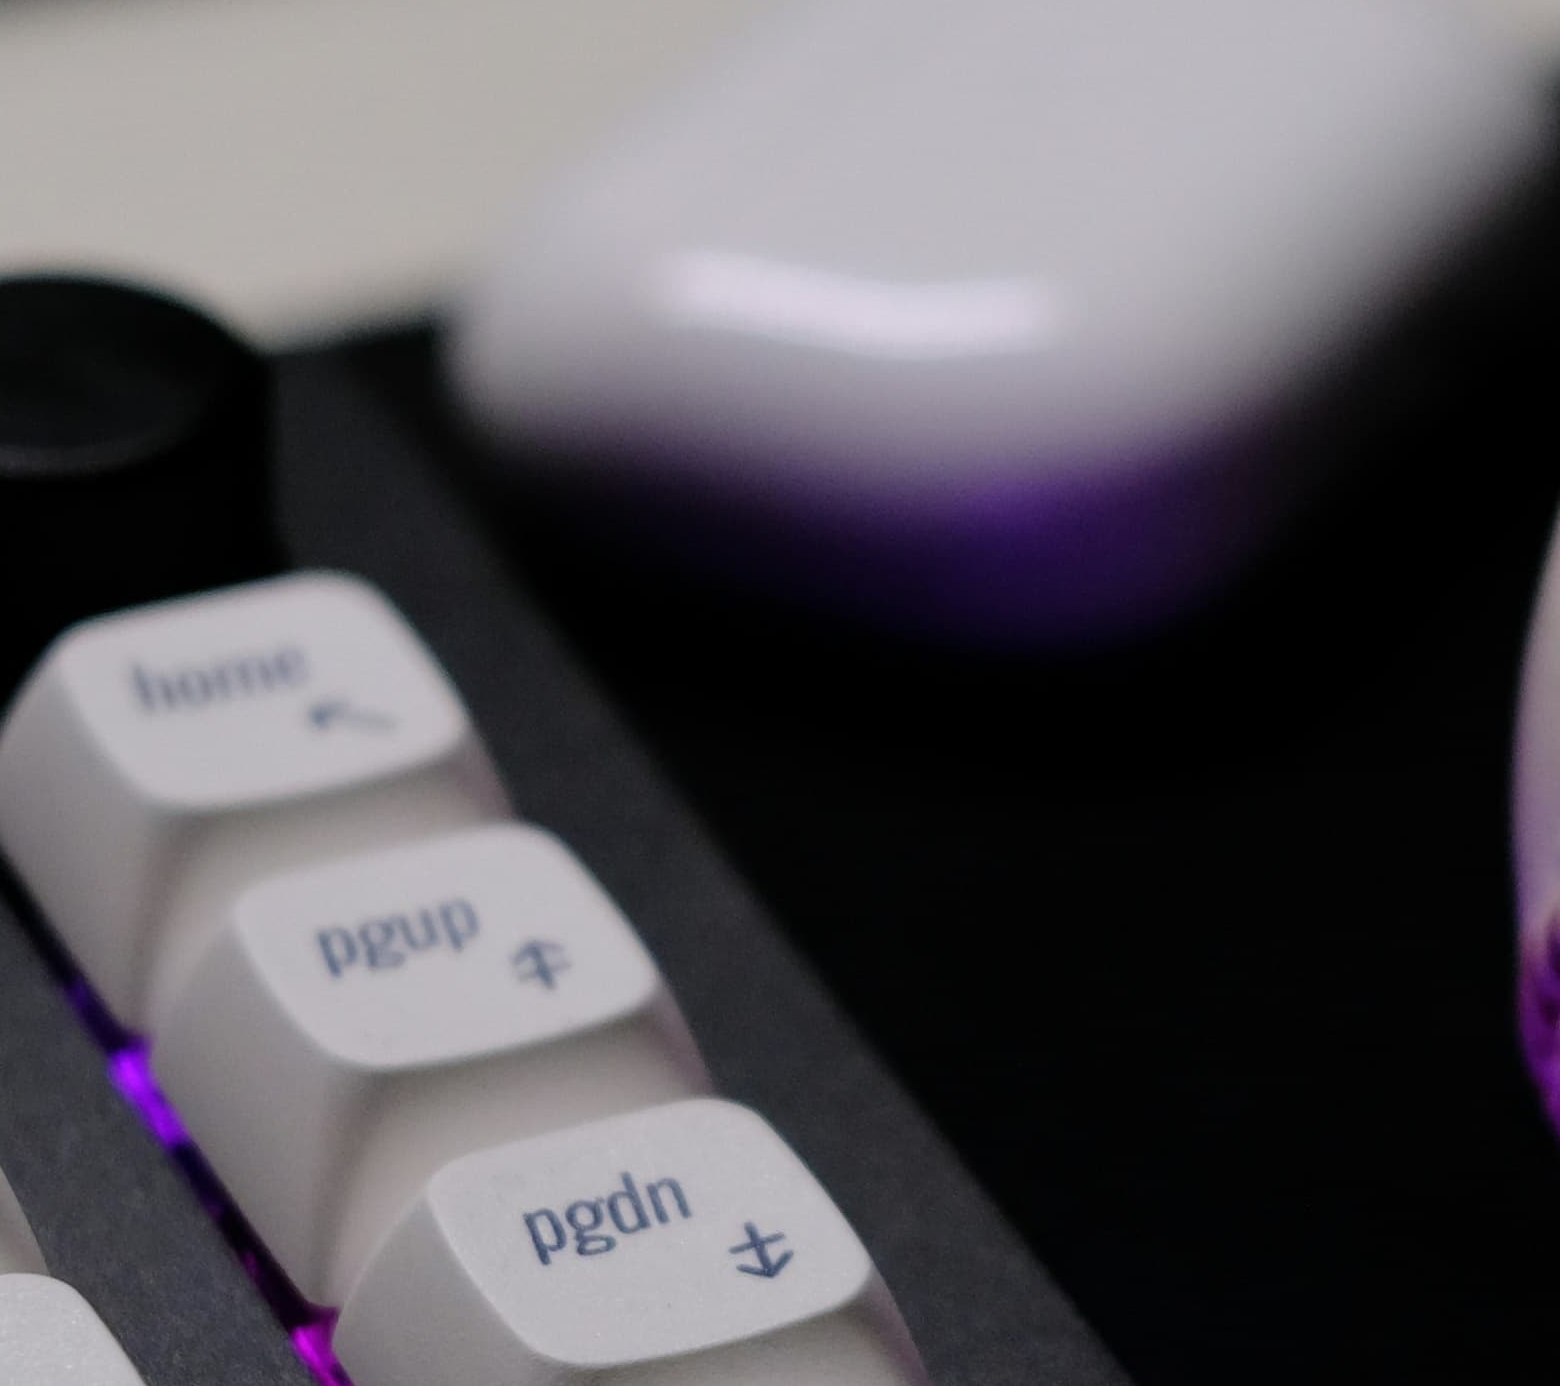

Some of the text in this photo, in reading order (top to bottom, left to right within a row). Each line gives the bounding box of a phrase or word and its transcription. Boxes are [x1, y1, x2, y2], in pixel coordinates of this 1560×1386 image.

[130, 643, 308, 715] home
[316, 896, 480, 980] pgup
[523, 1172, 692, 1266] pgdn
